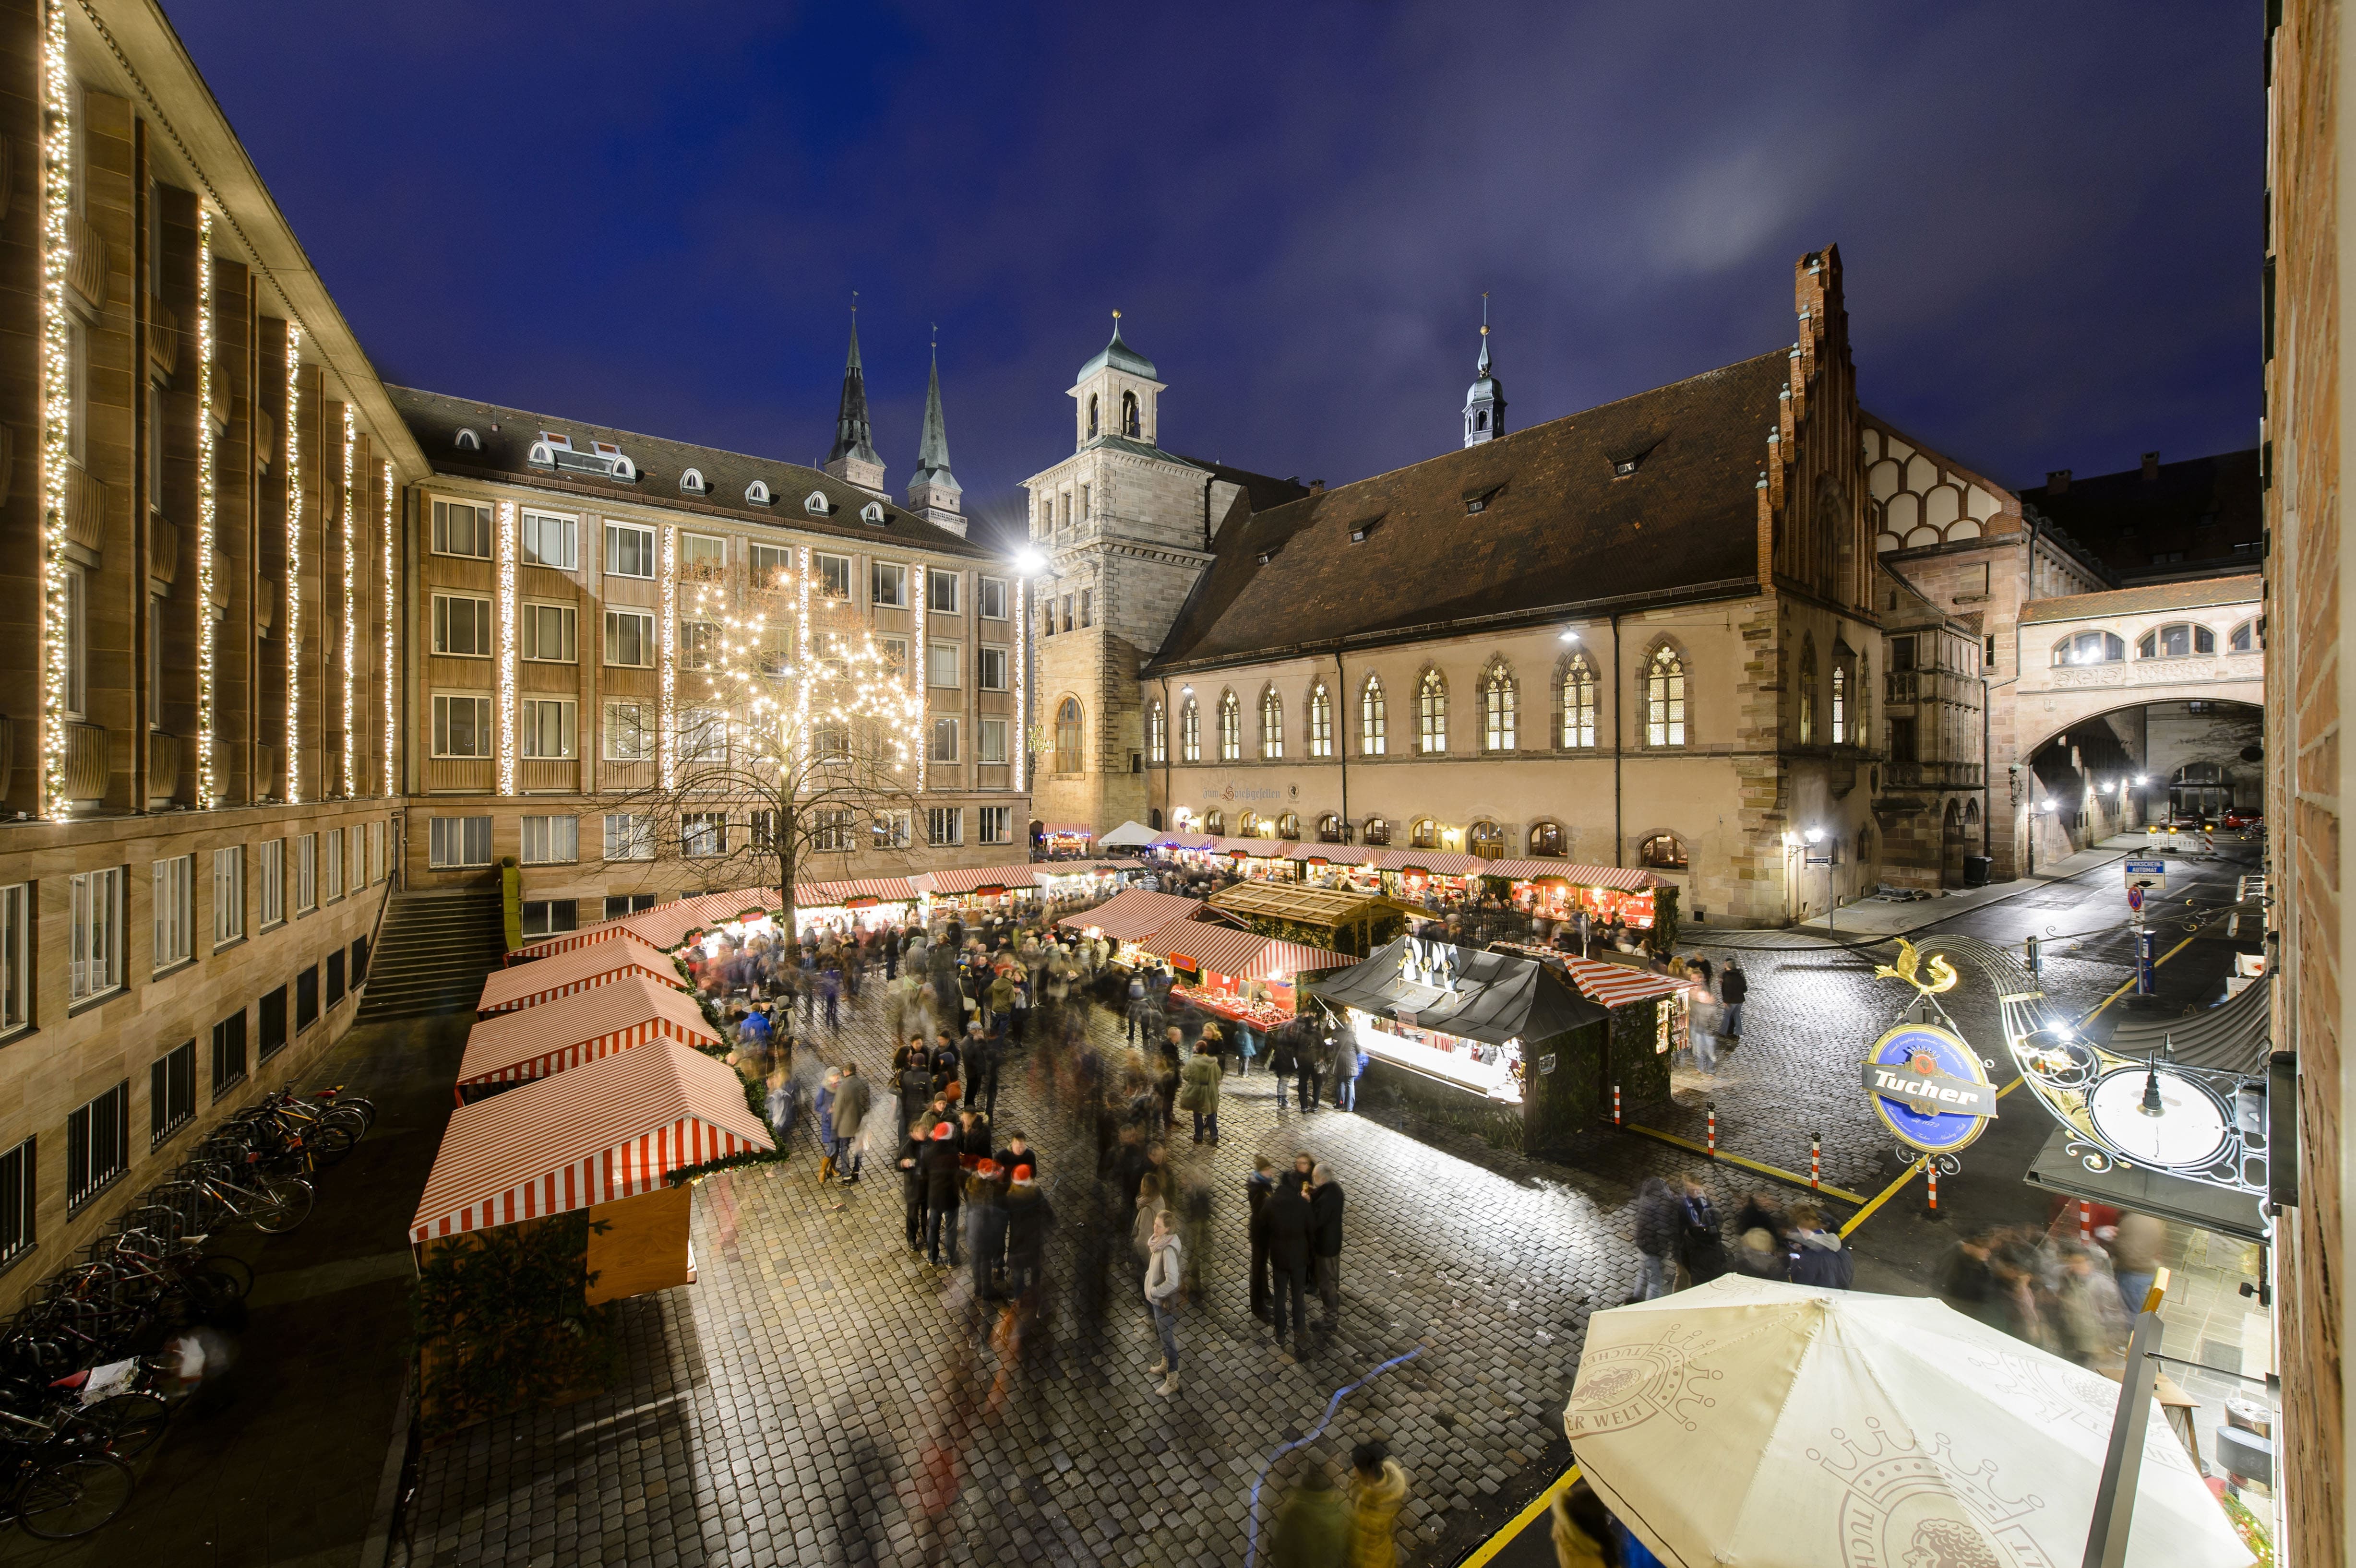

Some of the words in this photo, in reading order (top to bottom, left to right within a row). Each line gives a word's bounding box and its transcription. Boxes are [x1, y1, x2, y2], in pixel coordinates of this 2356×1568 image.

[1874, 1069, 1979, 1105] Tucher
[1921, 1120, 1940, 1128] 1672
[1593, 1402, 1642, 1428] WELT
[1850, 1508, 1878, 1568] TUCH
